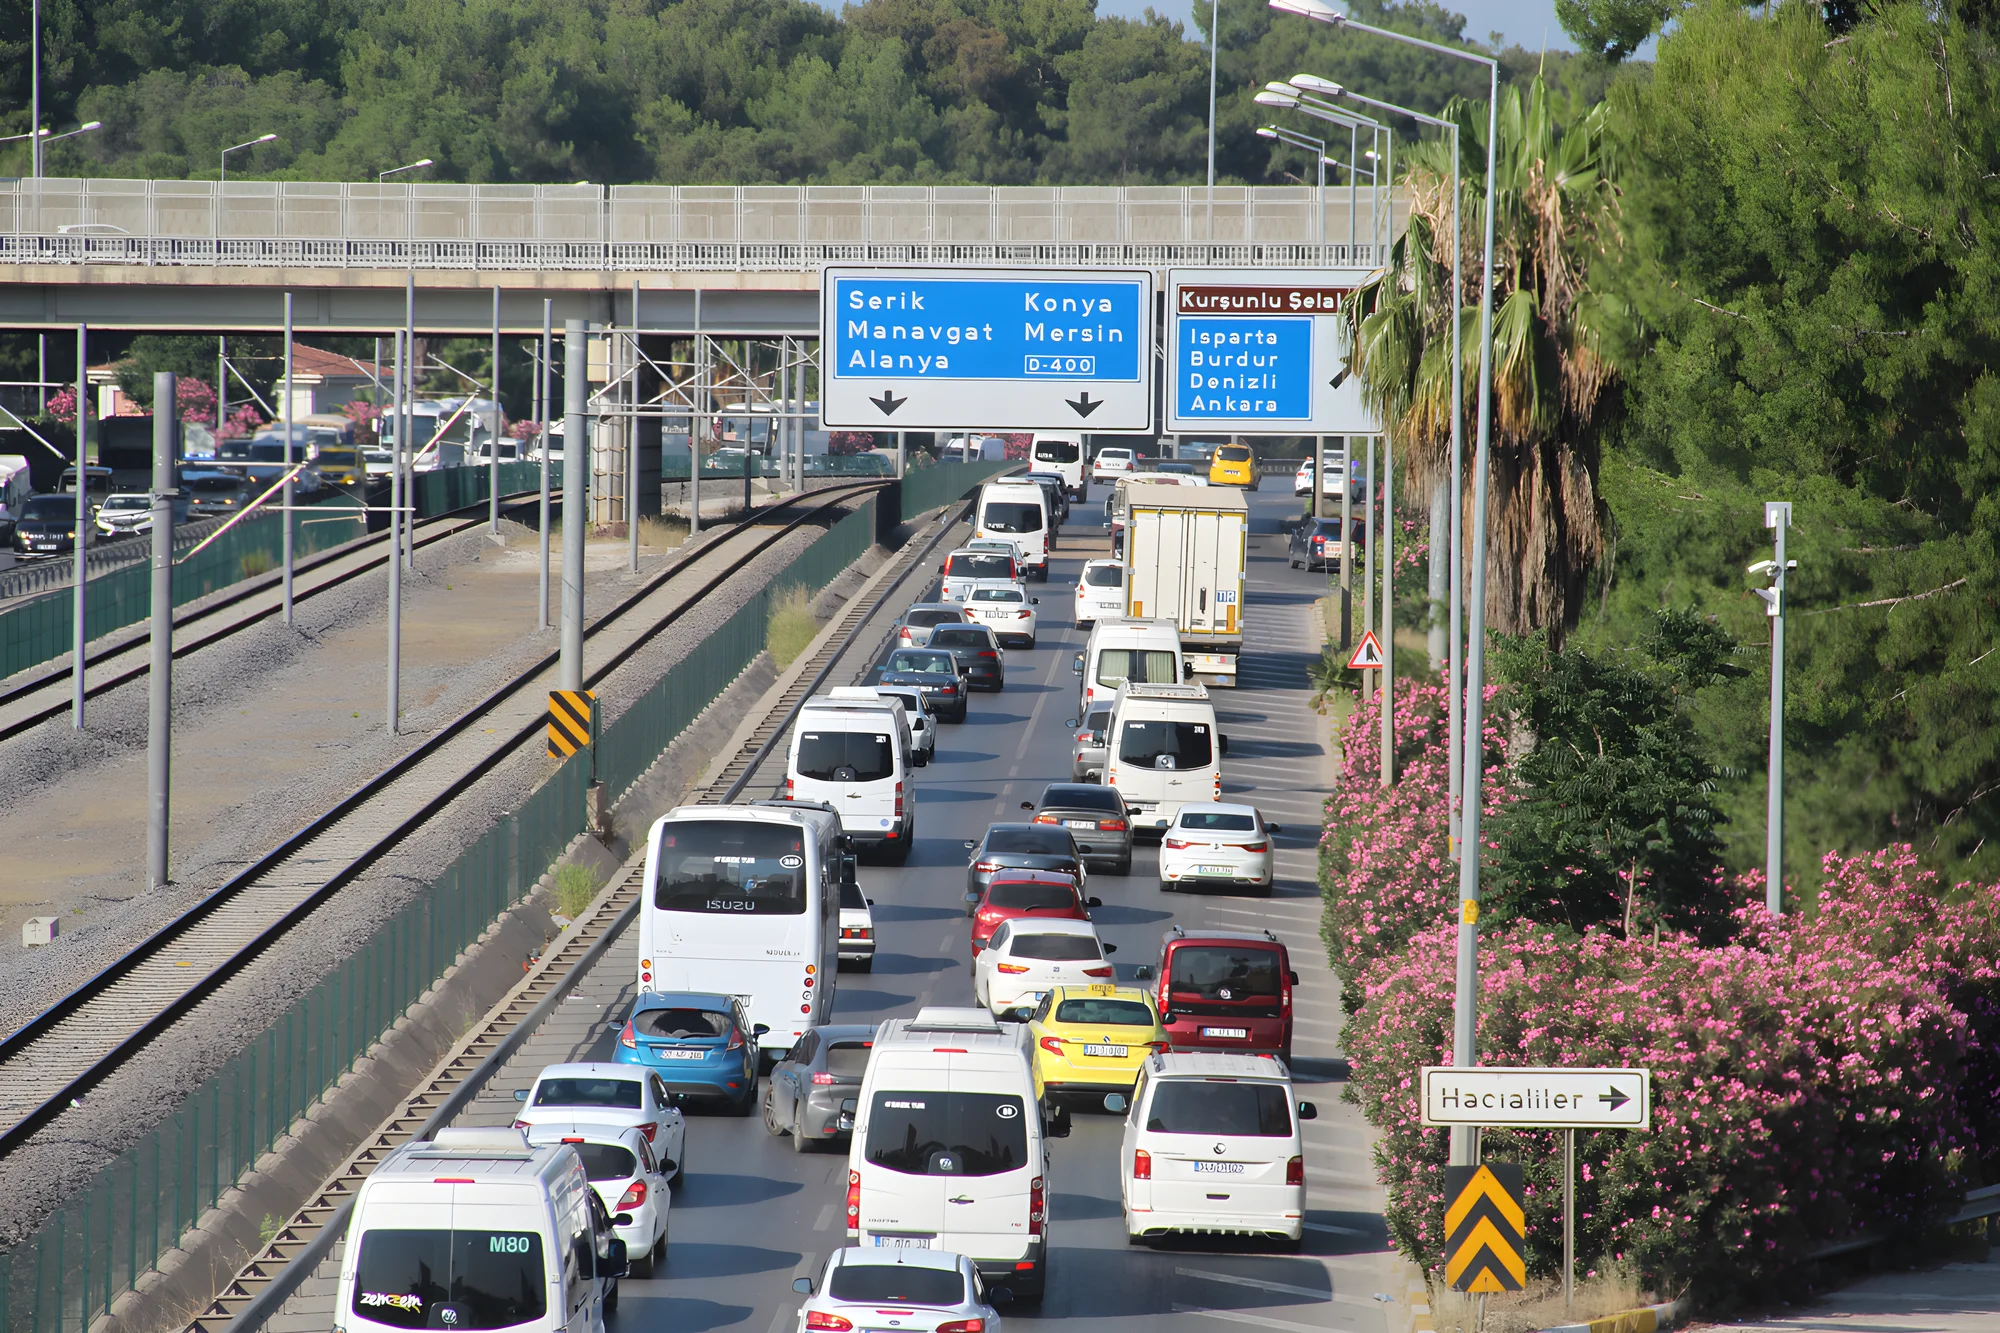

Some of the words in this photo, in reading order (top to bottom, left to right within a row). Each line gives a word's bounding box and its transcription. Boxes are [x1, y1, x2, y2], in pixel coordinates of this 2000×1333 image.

[849, 290, 925, 310] Serik
[1025, 292, 1112, 314] Konya
[1181, 291, 1281, 310] Kurşunlu
[848, 320, 993, 345] Manavgat
[1025, 322, 1123, 343] Mersin
[1190, 328, 1277, 347] Isparta
[848, 349, 949, 374] Alanya
[1029, 358, 1091, 372] D-400
[1190, 350, 1278, 367] Burdur
[1190, 372, 1277, 389] Denizli
[1190, 394, 1277, 412] Ankara
[706, 900, 755, 911] ISUZU
[489, 1236, 530, 1253] M80
